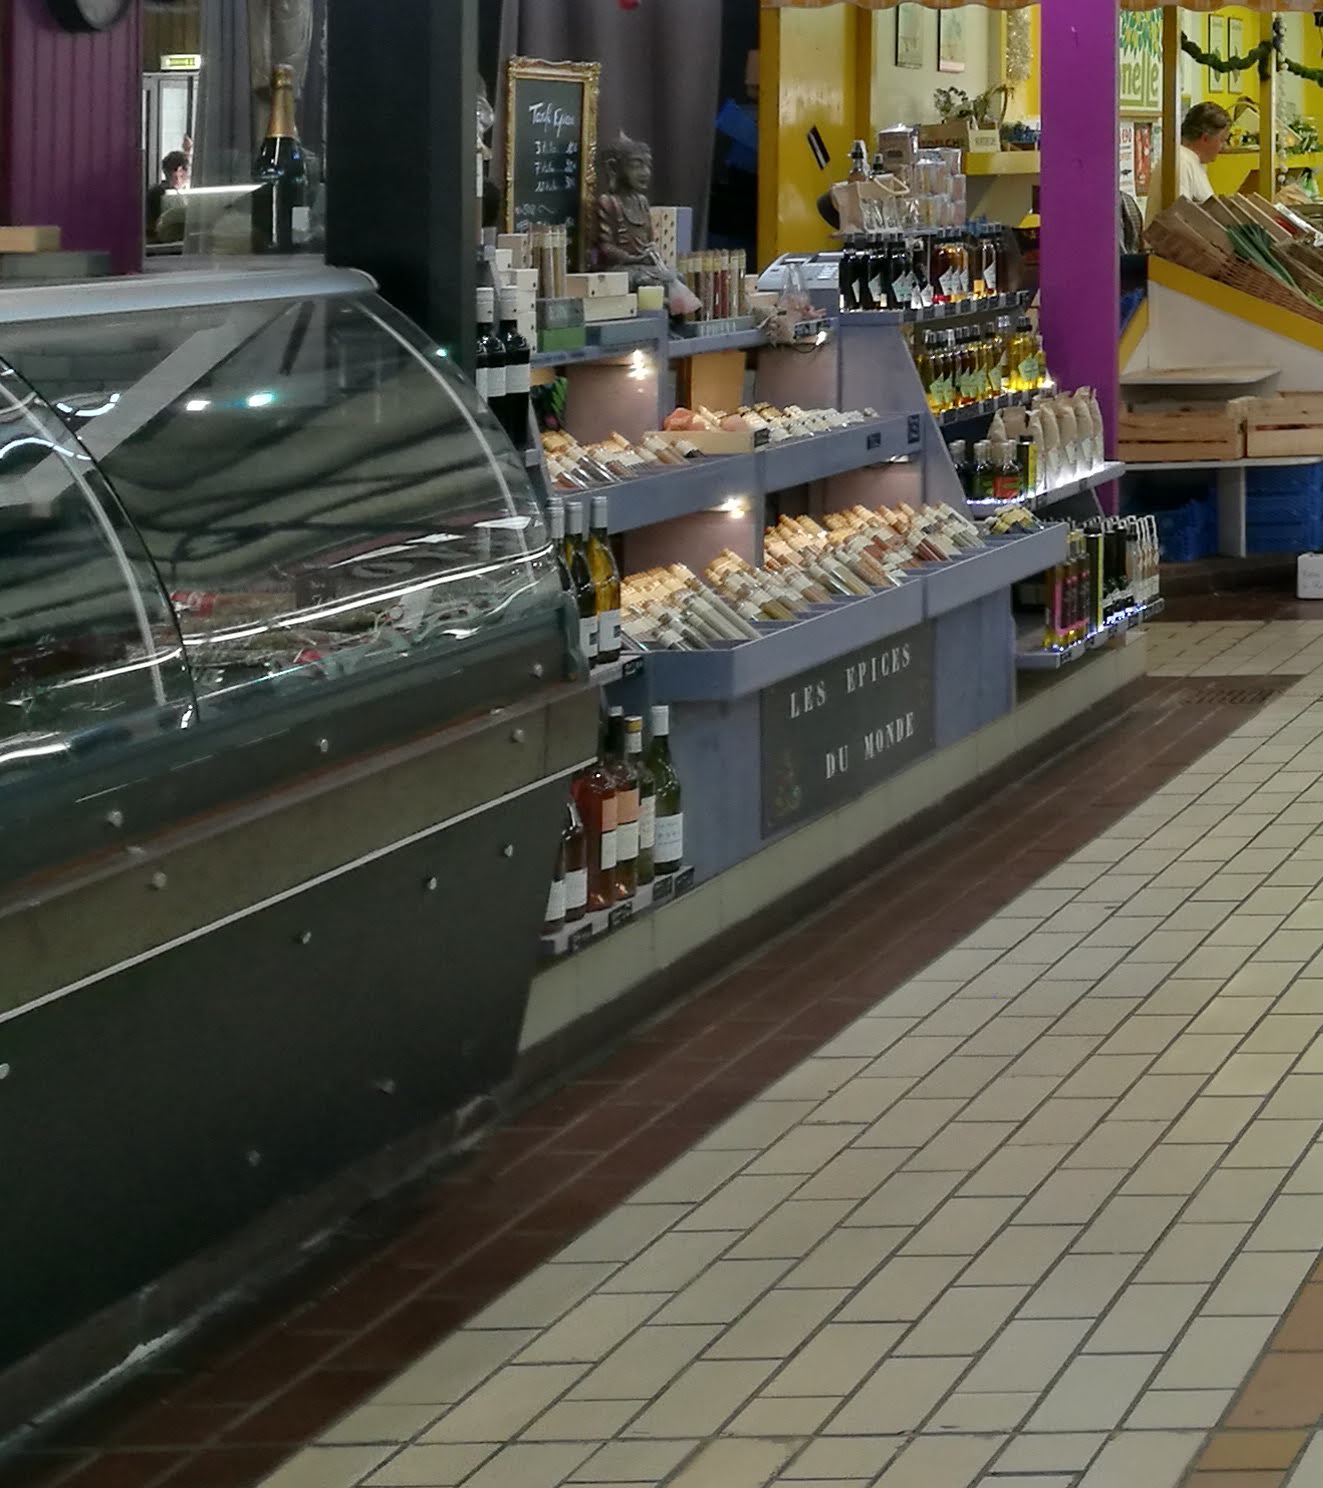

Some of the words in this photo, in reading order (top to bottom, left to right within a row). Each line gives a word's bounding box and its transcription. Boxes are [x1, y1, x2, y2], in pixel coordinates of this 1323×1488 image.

[789, 680, 827, 719] LES
[845, 643, 911, 694] EPICES
[825, 745, 849, 779] DU
[863, 711, 915, 760] MONDE
